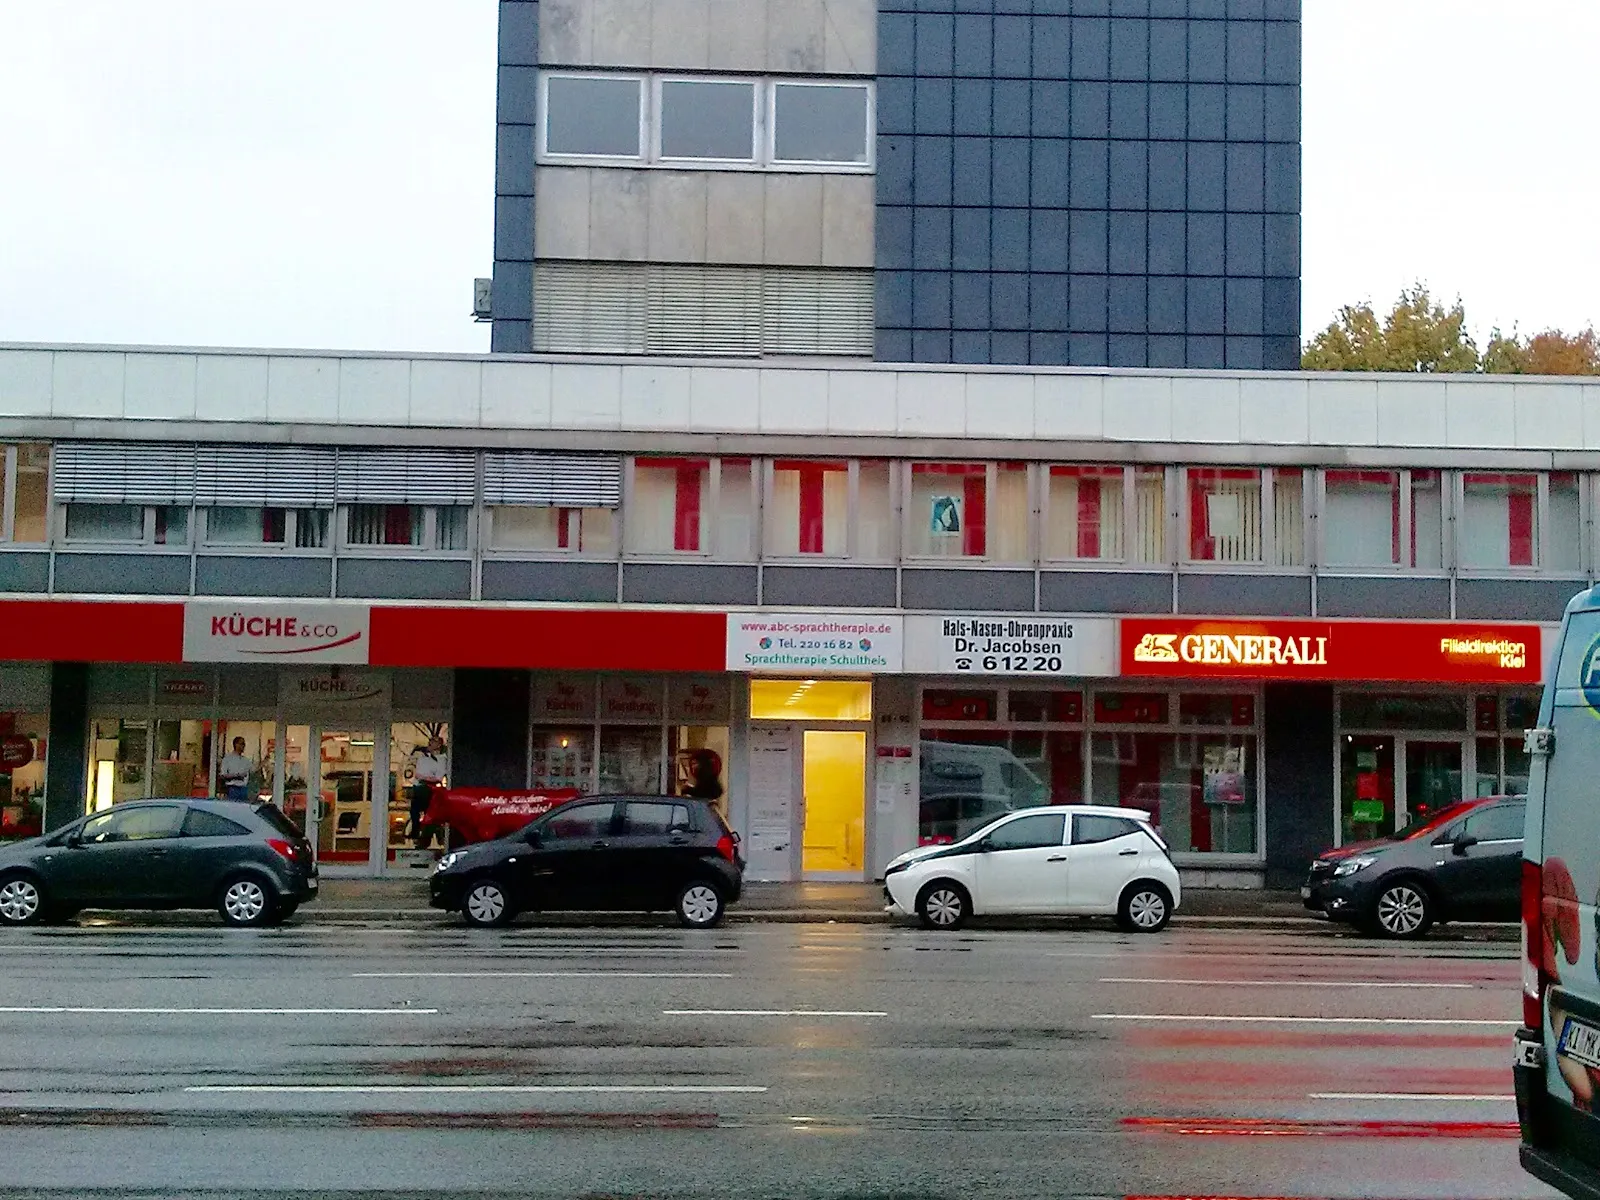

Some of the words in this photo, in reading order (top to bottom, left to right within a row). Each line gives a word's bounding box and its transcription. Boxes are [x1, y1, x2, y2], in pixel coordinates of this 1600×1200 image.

[211, 612, 298, 637] KÜCHE
[741, 621, 892, 634] www.abc-sprachtherapie.de
[943, 619, 1074, 640] Hals-Nasen-Ohrenpraxis
[779, 638, 797, 649] Tel.
[800, 640, 821, 649] 220
[823, 639, 836, 649] 16
[839, 640, 853, 650] 82
[955, 637, 979, 653] Dr.
[982, 638, 1062, 655] Jacobsen
[1179, 633, 1328, 665] GENERALI
[1440, 637, 1526, 654] Filialdirektion
[744, 653, 827, 667] Sprachtherapie
[830, 654, 887, 666] Schultheis
[1500, 653, 1526, 668] Kiel
